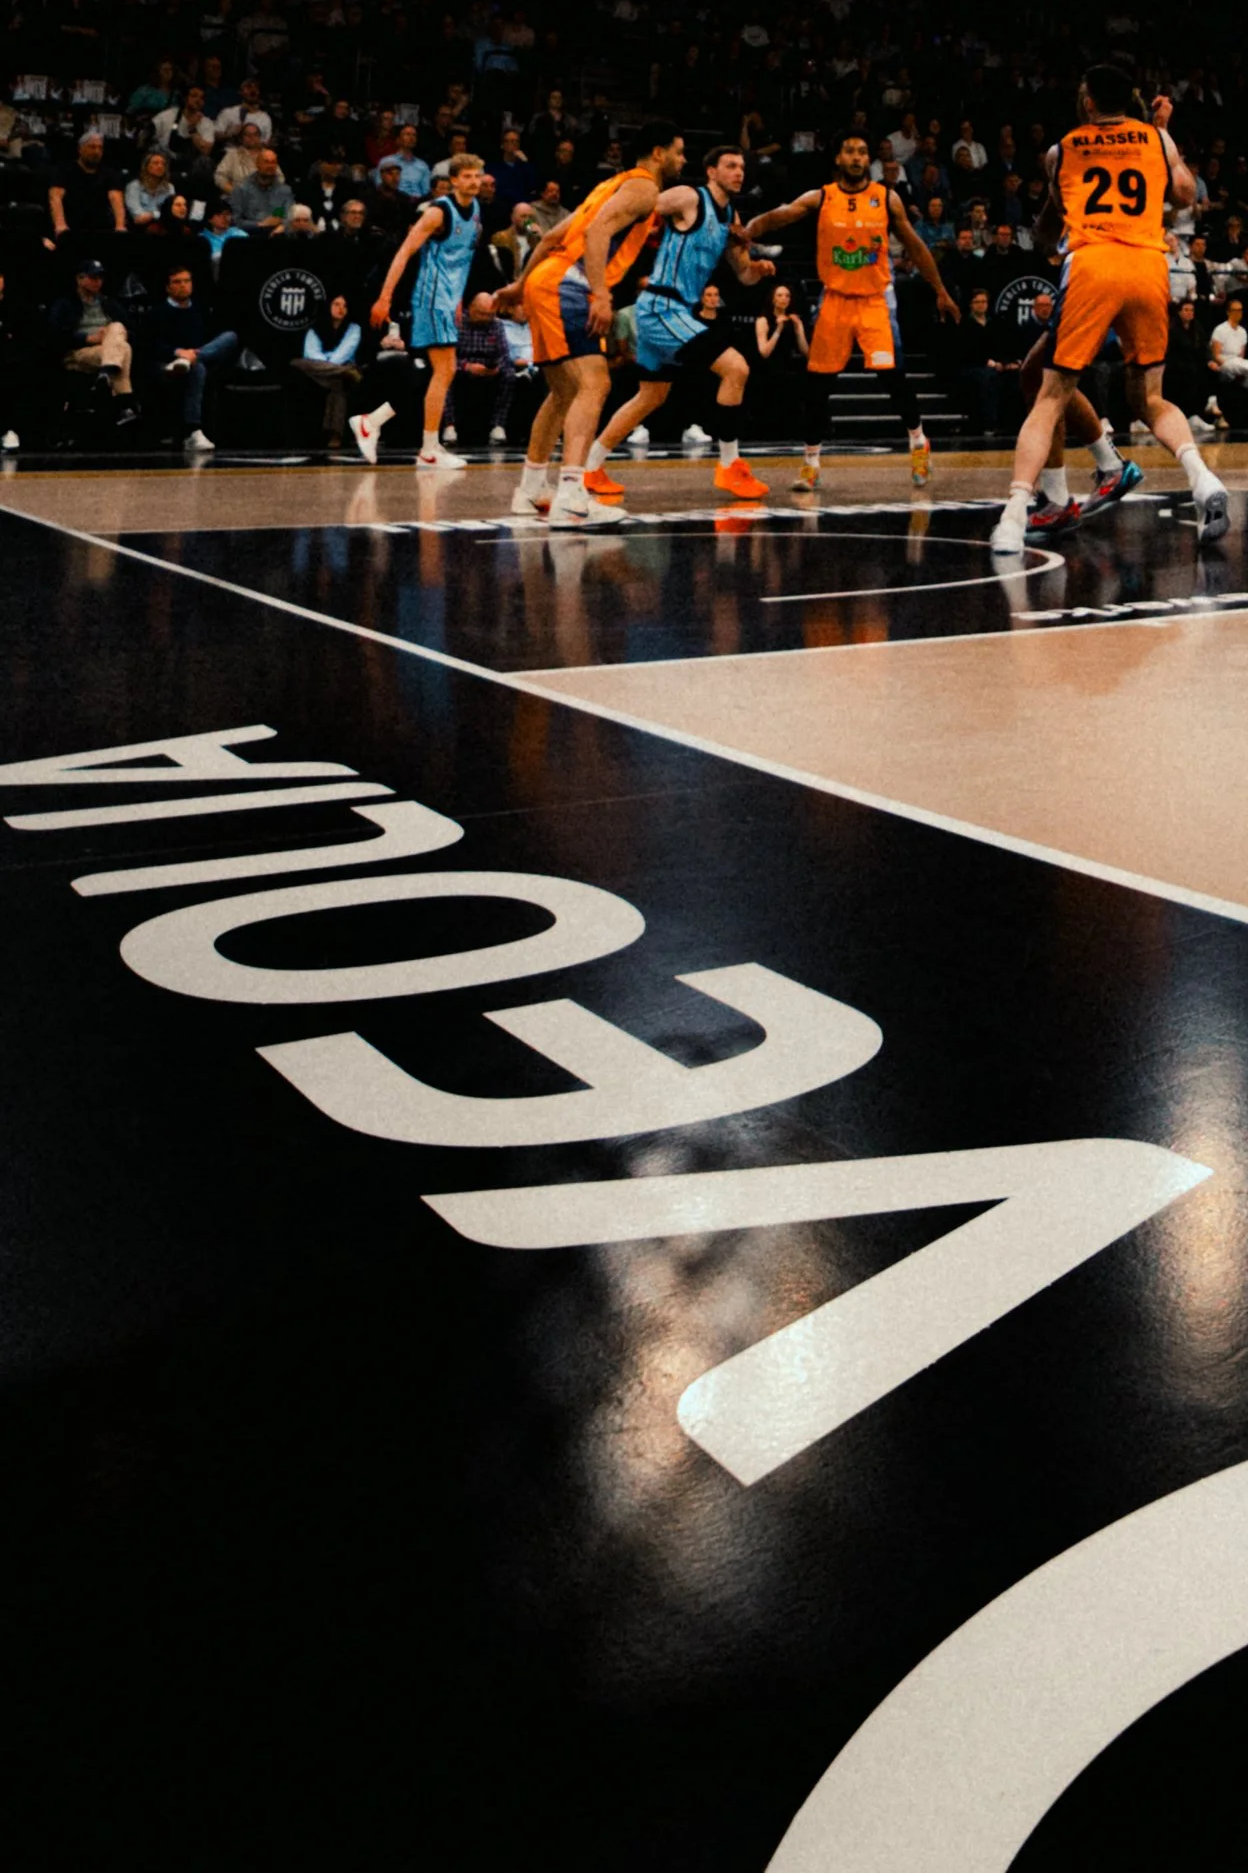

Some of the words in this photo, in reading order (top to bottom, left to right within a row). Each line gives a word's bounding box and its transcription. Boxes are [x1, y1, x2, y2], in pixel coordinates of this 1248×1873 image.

[1072, 131, 1149, 147] KLASSEN
[848, 198, 857, 212] 5
[1082, 166, 1147, 217] 29
[0, 724, 1214, 1487] VEOLIA
